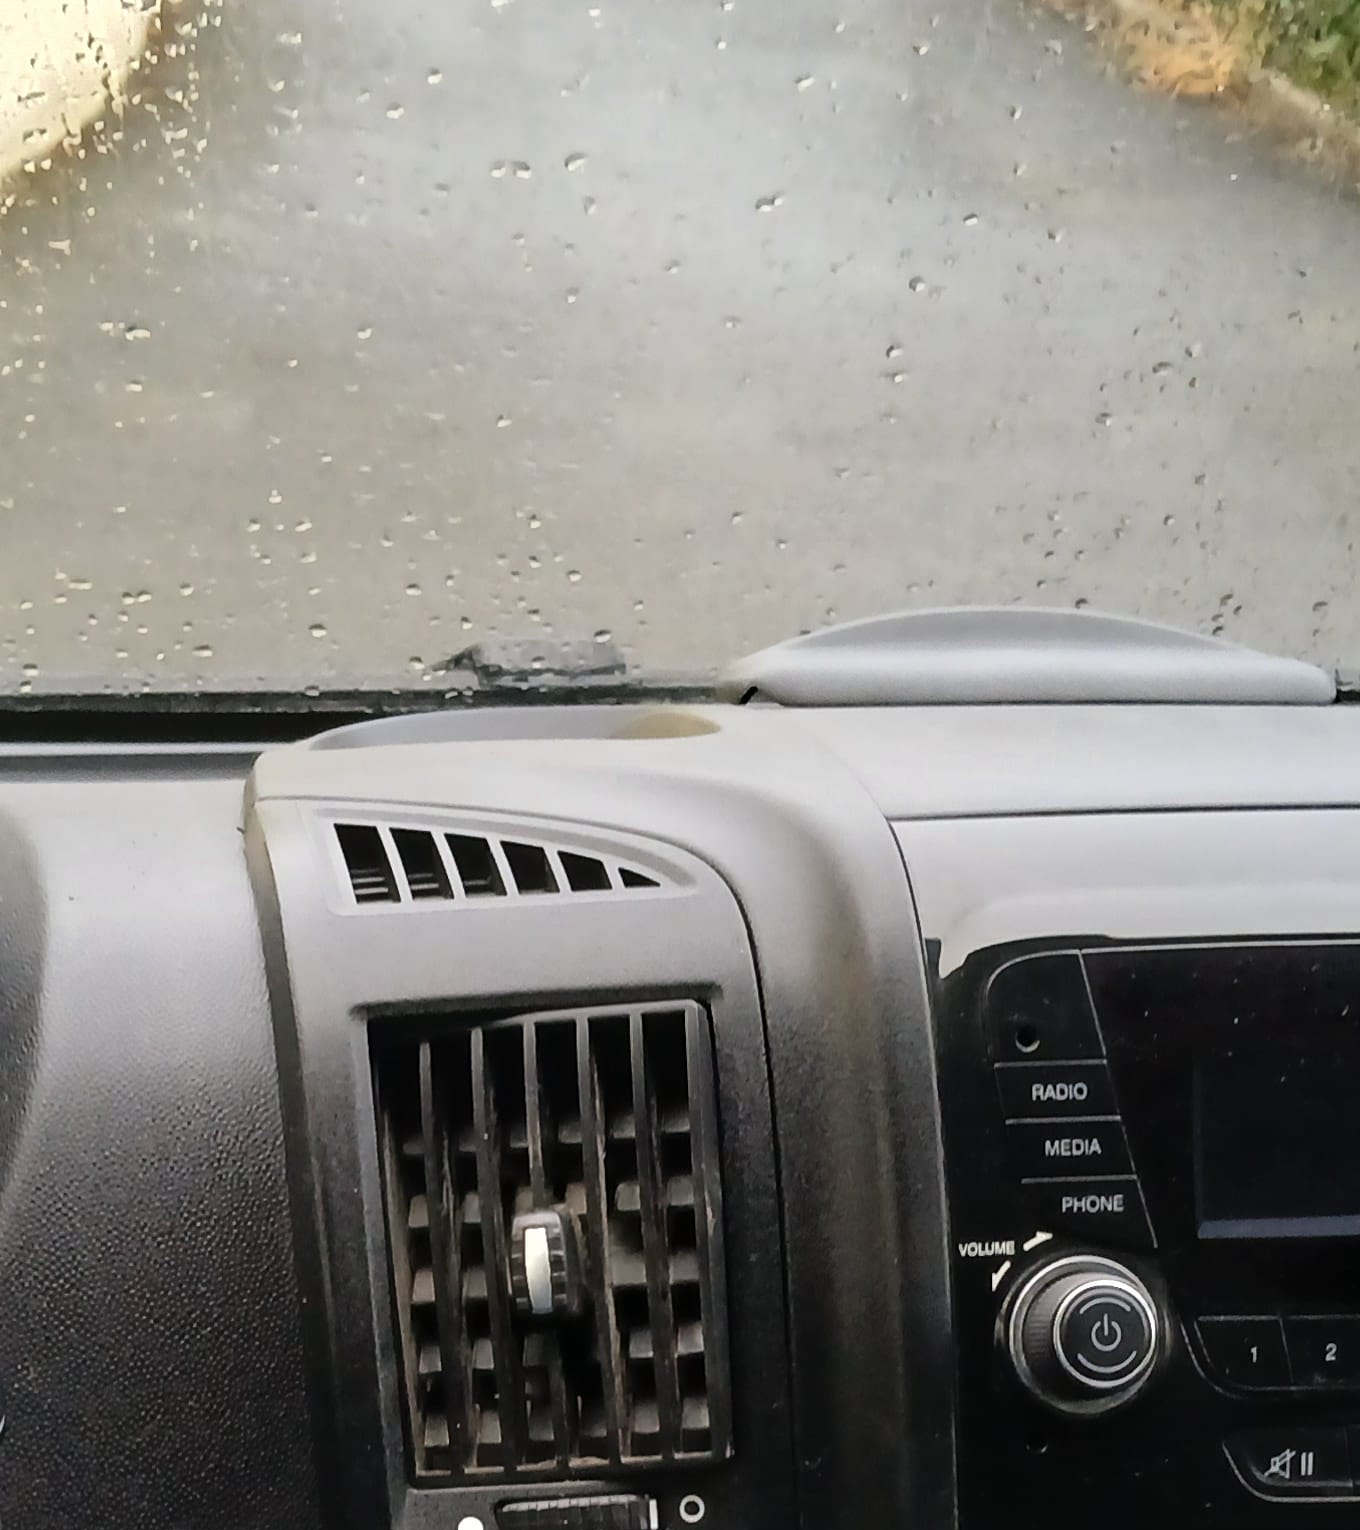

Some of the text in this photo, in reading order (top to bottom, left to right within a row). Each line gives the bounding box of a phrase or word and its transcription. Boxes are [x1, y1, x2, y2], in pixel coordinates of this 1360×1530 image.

[1031, 1082, 1088, 1101] RADIO
[1044, 1137, 1102, 1157] MEDIA
[1061, 1194, 1124, 1213] PHONE
[958, 1240, 1016, 1257] VOLUME
[1250, 1346, 1258, 1363] 1
[1325, 1342, 1337, 1362] 2
